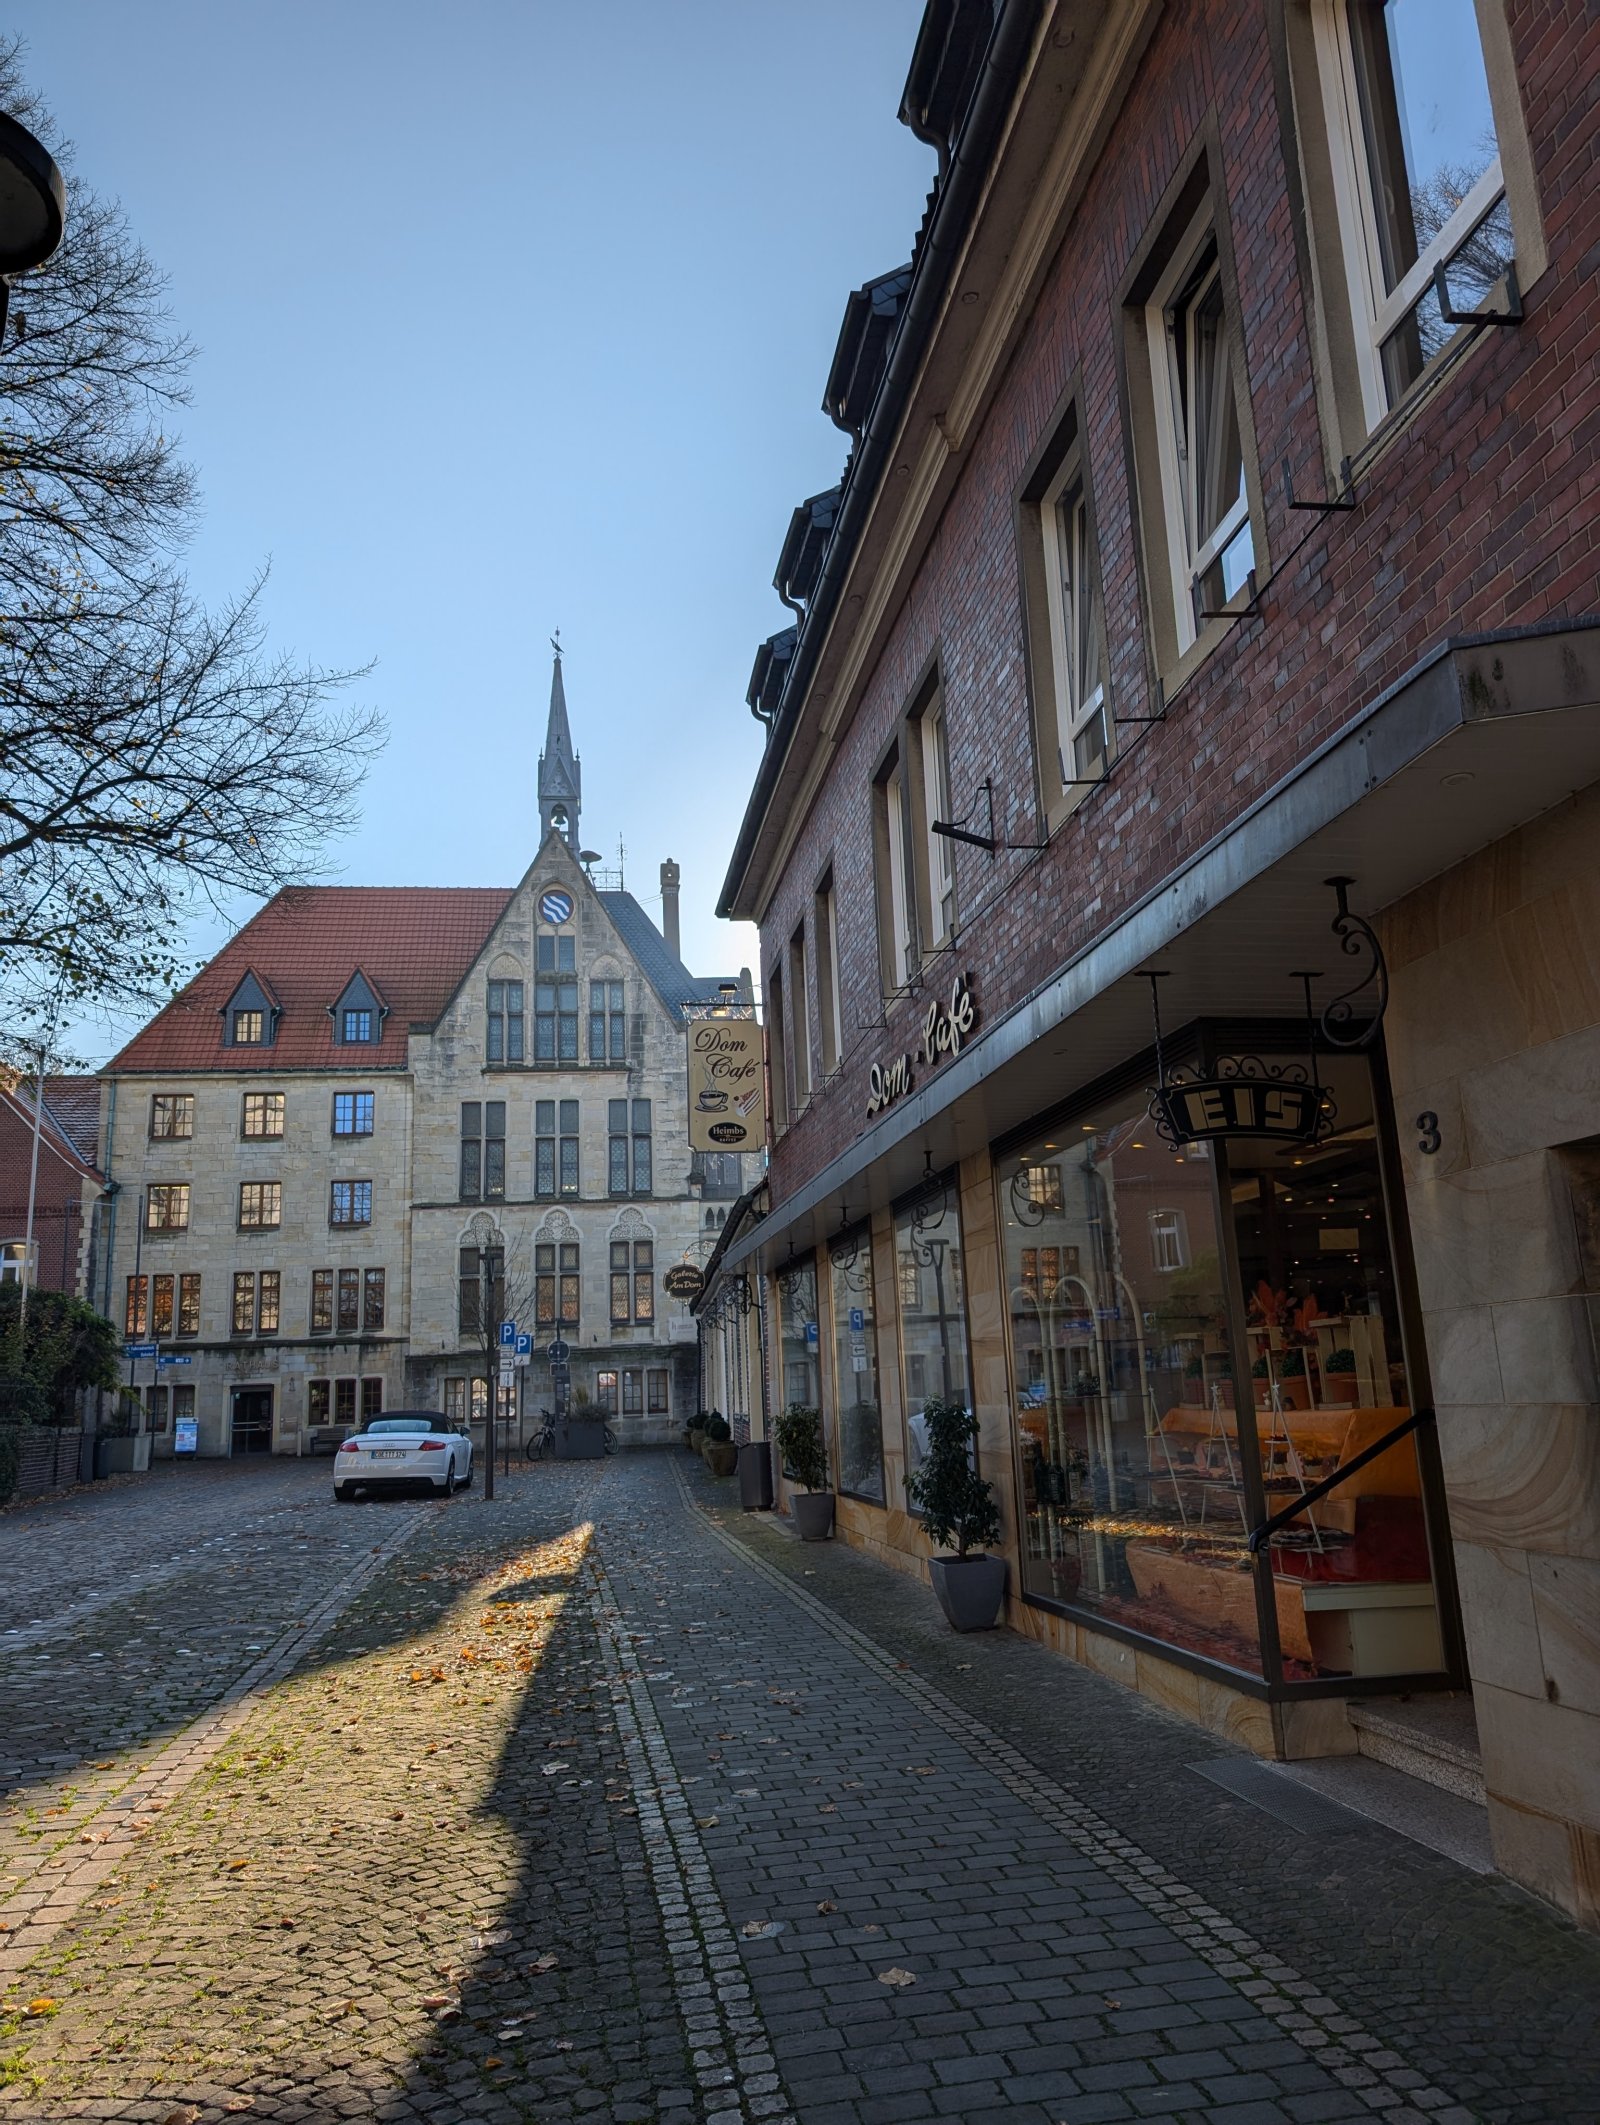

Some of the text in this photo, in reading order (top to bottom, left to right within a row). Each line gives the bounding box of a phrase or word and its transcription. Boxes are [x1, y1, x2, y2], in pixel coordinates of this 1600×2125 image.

[693, 1027, 748, 1052] Dom
[706, 1053, 760, 1085] Café
[1184, 1088, 1303, 1131] EIS
[713, 1126, 744, 1135] Heimbs
[1416, 1111, 1442, 1154] 3
[671, 1270, 698, 1280] Galerie
[670, 1280, 701, 1289] Am Dom
[504, 1325, 512, 1342] P
[518, 1336, 527, 1352] P
[225, 1360, 280, 1371] RATHAUS
